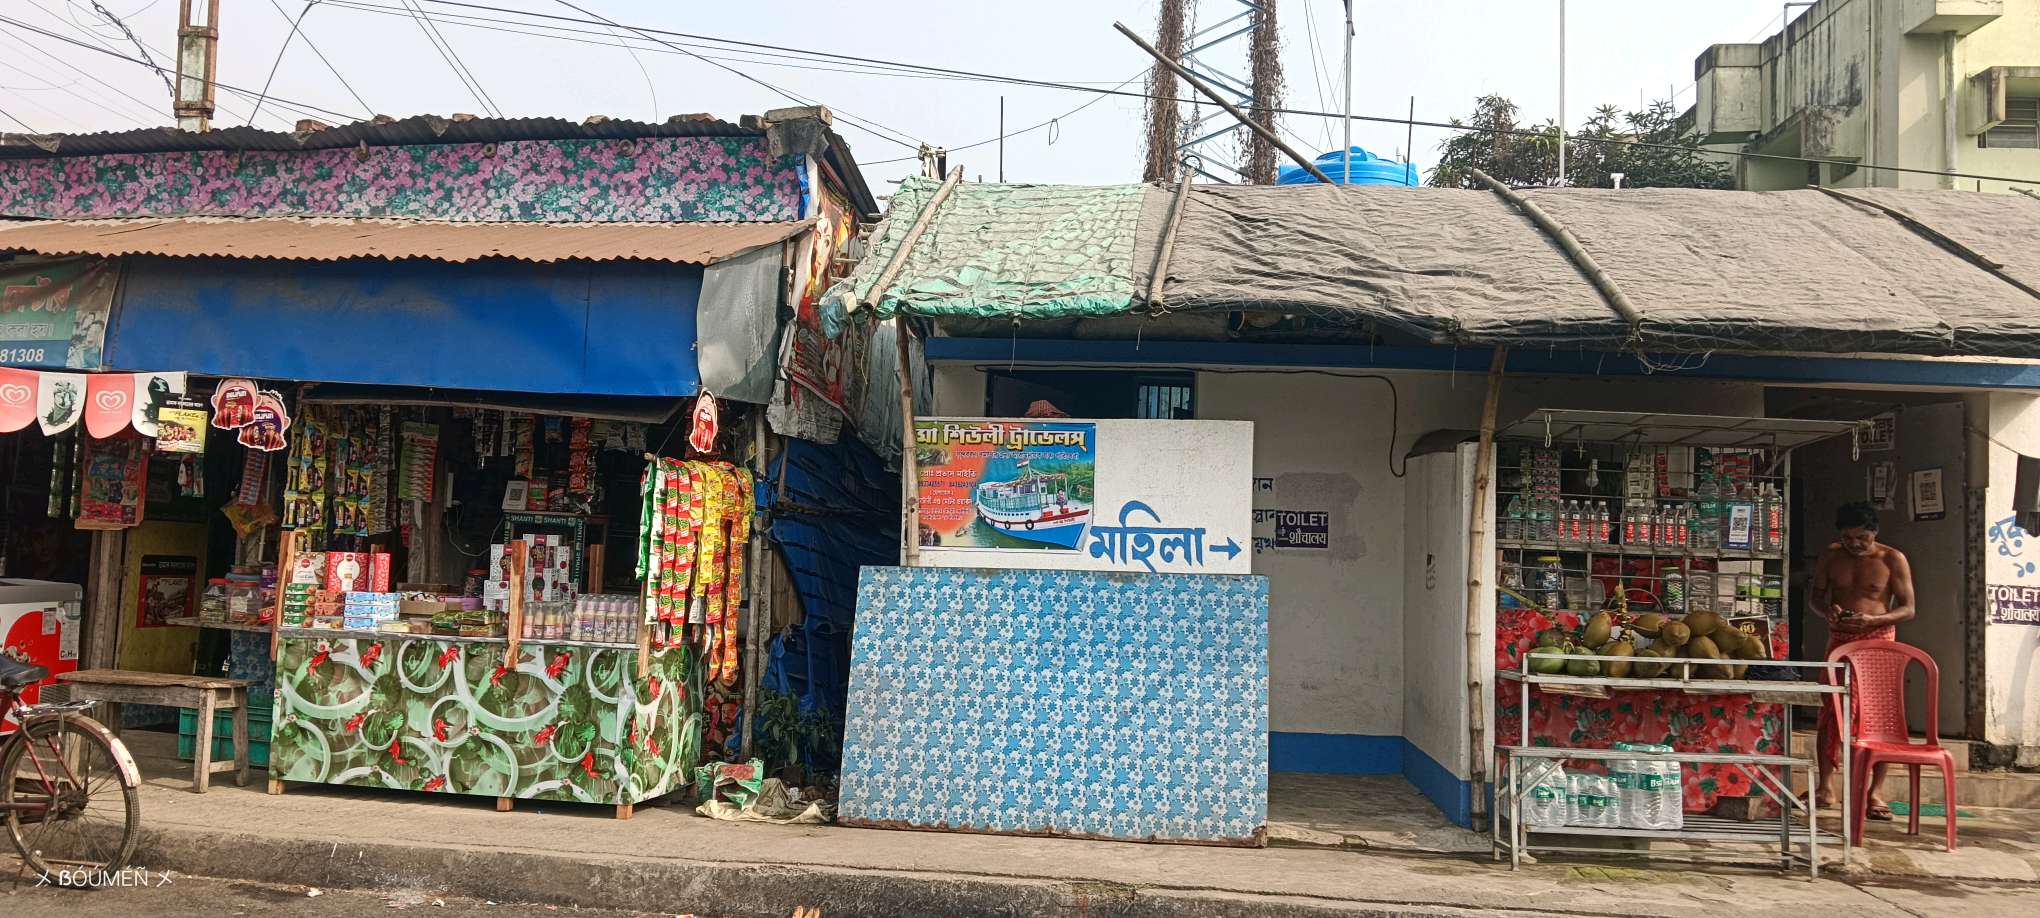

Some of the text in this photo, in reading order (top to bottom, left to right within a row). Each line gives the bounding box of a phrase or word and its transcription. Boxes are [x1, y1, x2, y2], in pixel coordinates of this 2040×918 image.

[915, 427, 938, 445] মা
[943, 423, 1005, 445] শিউলী
[1277, 513, 1327, 527] TOILET
[1089, 500, 1206, 574] মহিলা
[1289, 528, 1327, 545] शौचालय
[1990, 586, 2040, 602] TOILET
